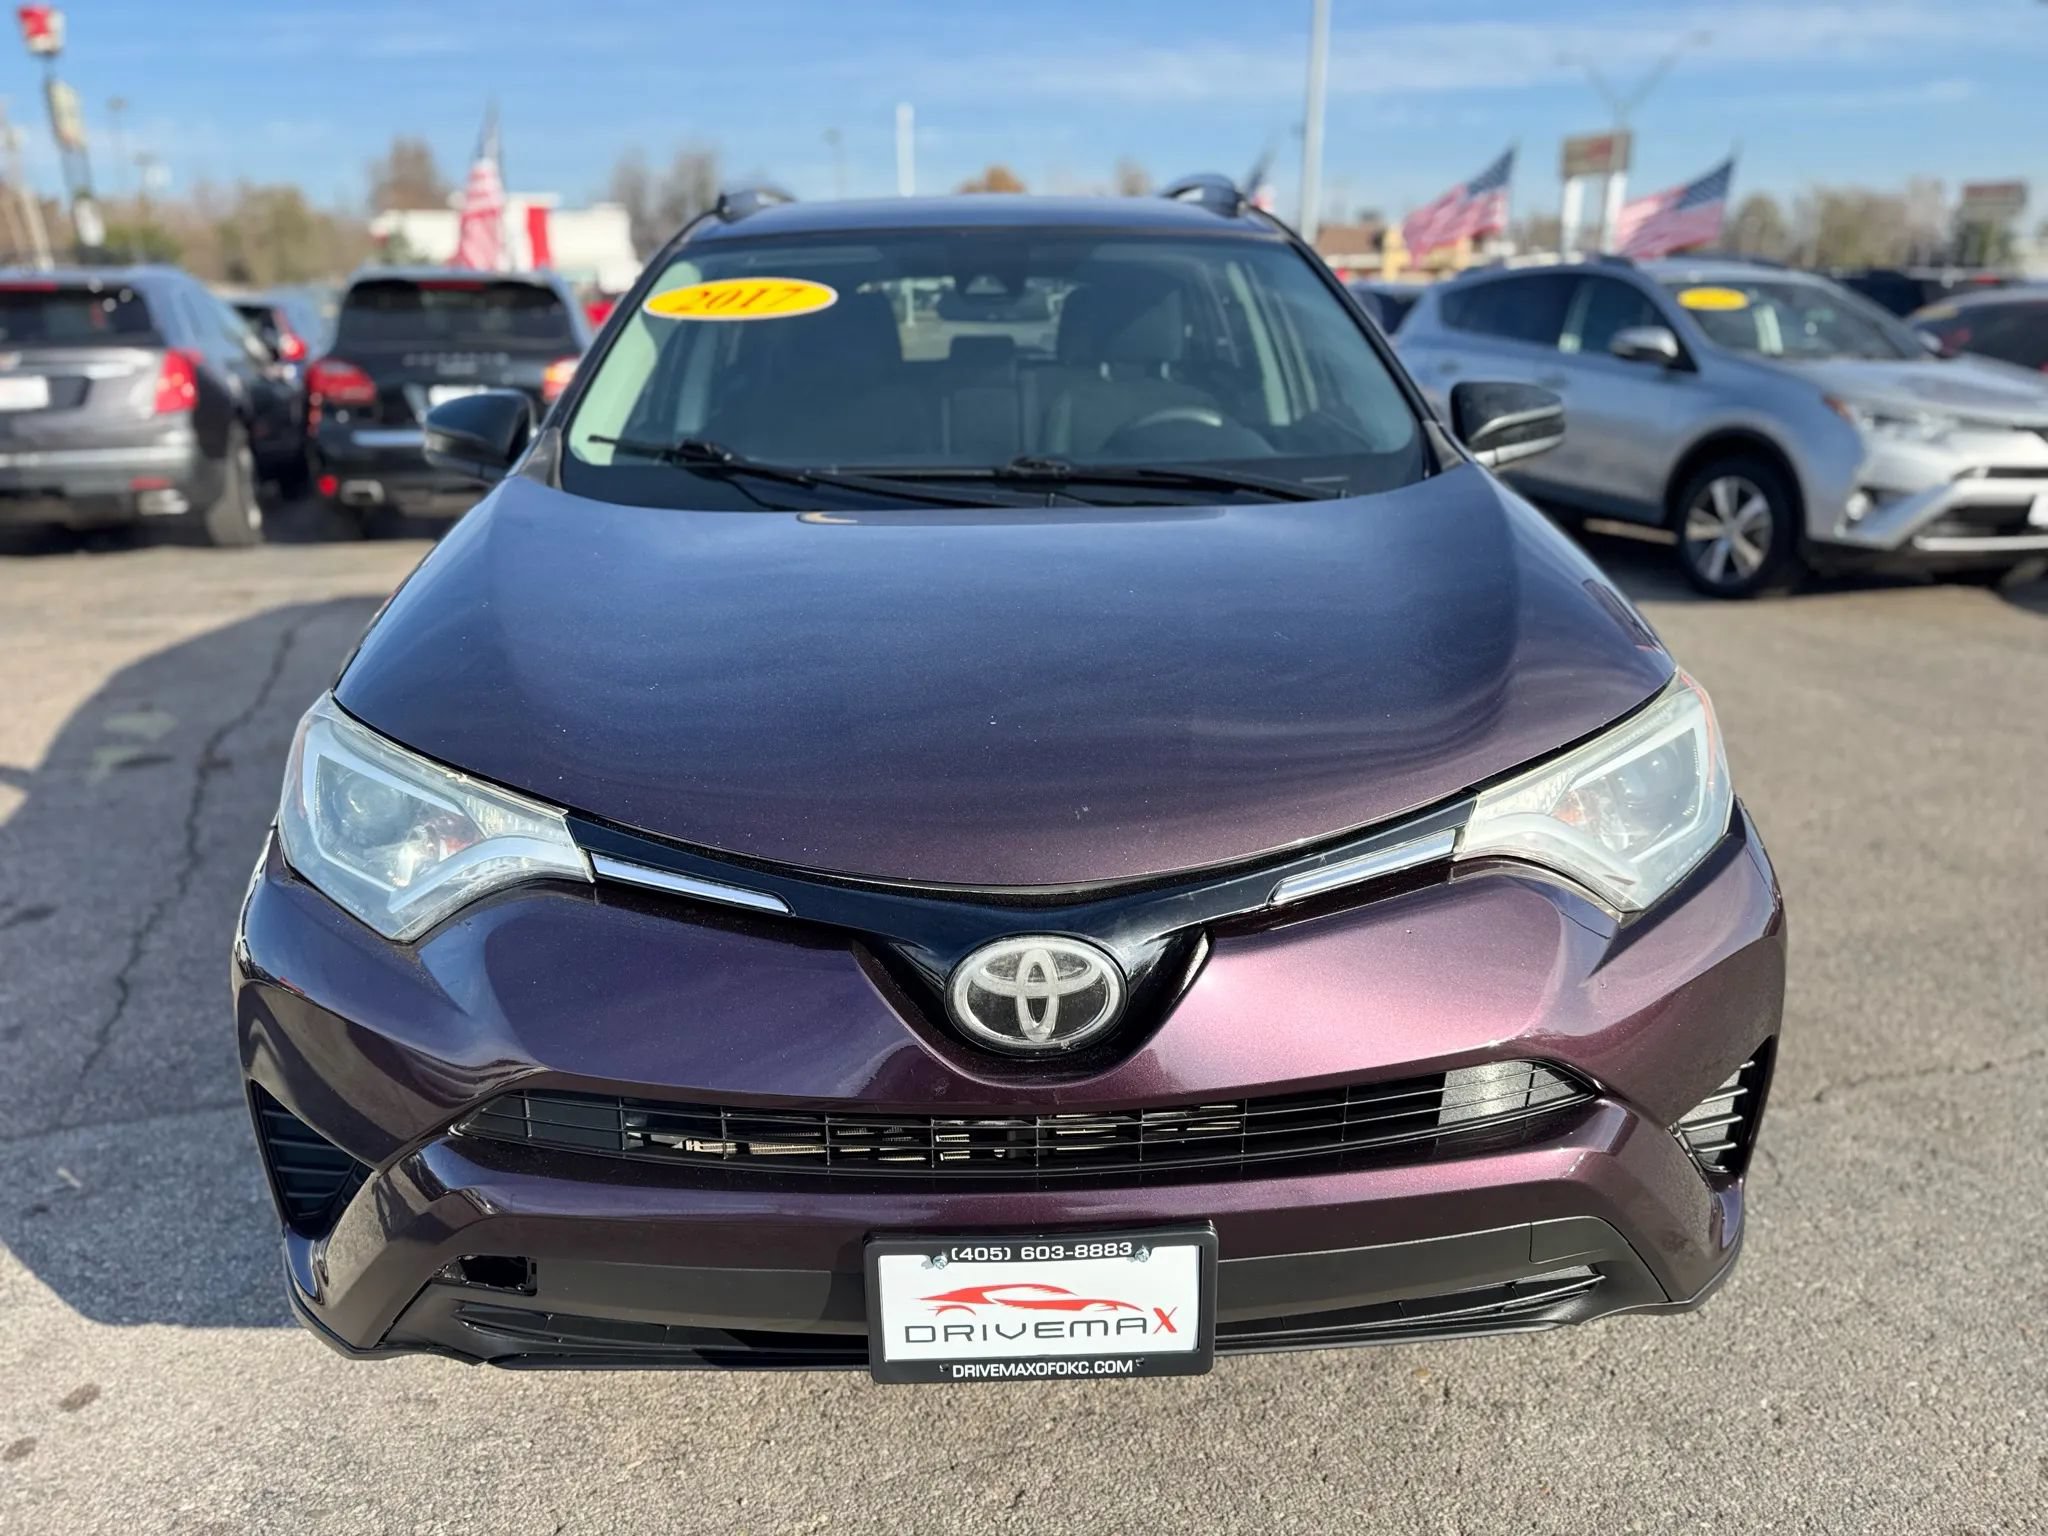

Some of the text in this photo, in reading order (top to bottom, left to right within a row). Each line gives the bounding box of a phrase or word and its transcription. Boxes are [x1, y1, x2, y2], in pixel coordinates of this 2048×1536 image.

[668, 286, 809, 313] 2017
[951, 1241, 1133, 1261] (405) 603-8883
[904, 1306, 1178, 1344] DRIVEMAX
[952, 1359, 1133, 1379] DRIVEMAXOFOKC.COM
